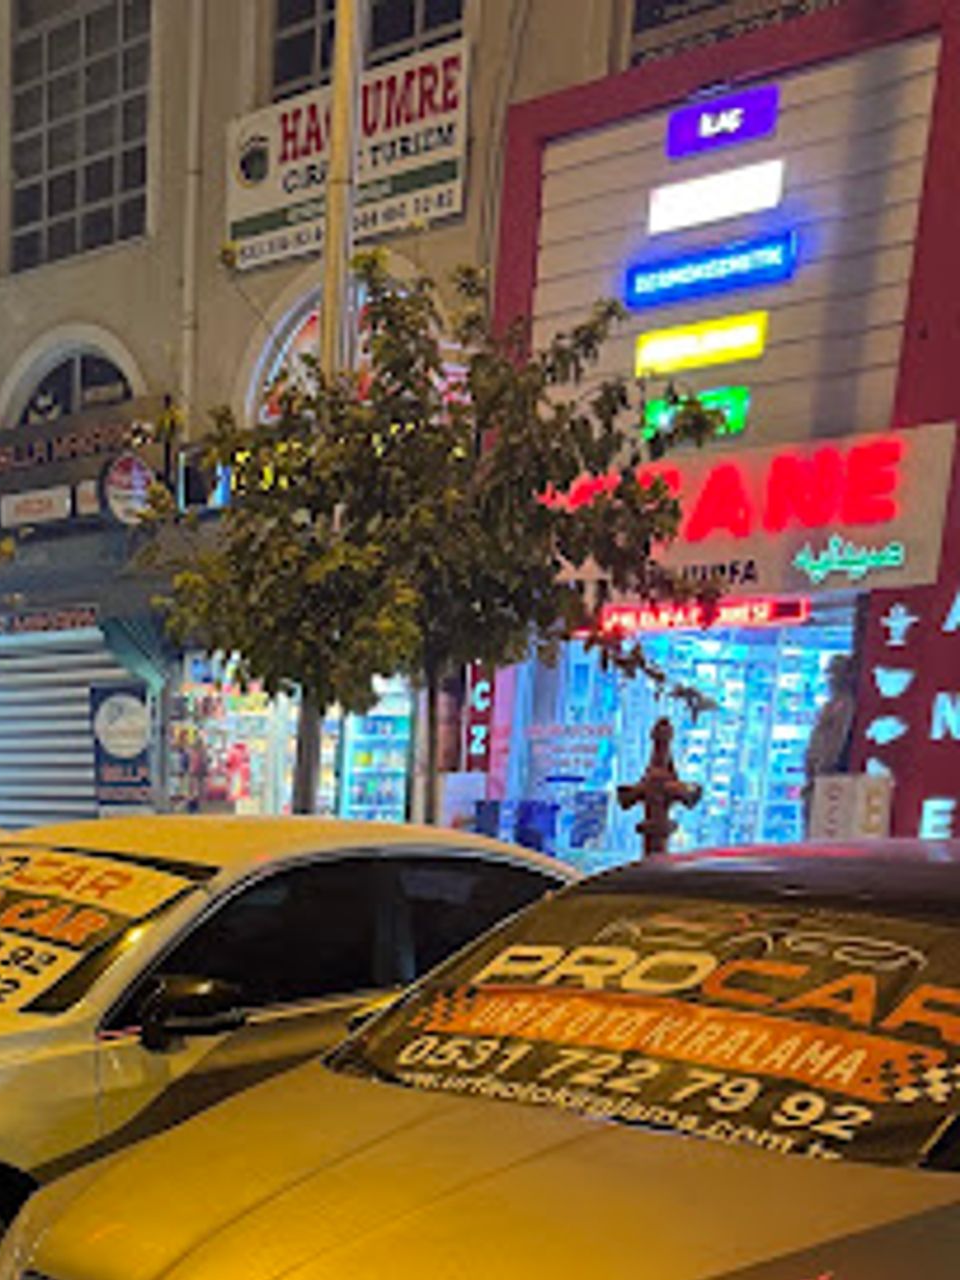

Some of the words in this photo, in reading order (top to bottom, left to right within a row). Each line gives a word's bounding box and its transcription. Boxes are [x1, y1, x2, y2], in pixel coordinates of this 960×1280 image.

[360, 55, 462, 138] UMRE
[397, 1034, 533, 1075] 0531
[539, 1048, 661, 1094] 722
[668, 1067, 762, 1113] 79
[770, 1091, 874, 1141] 92
